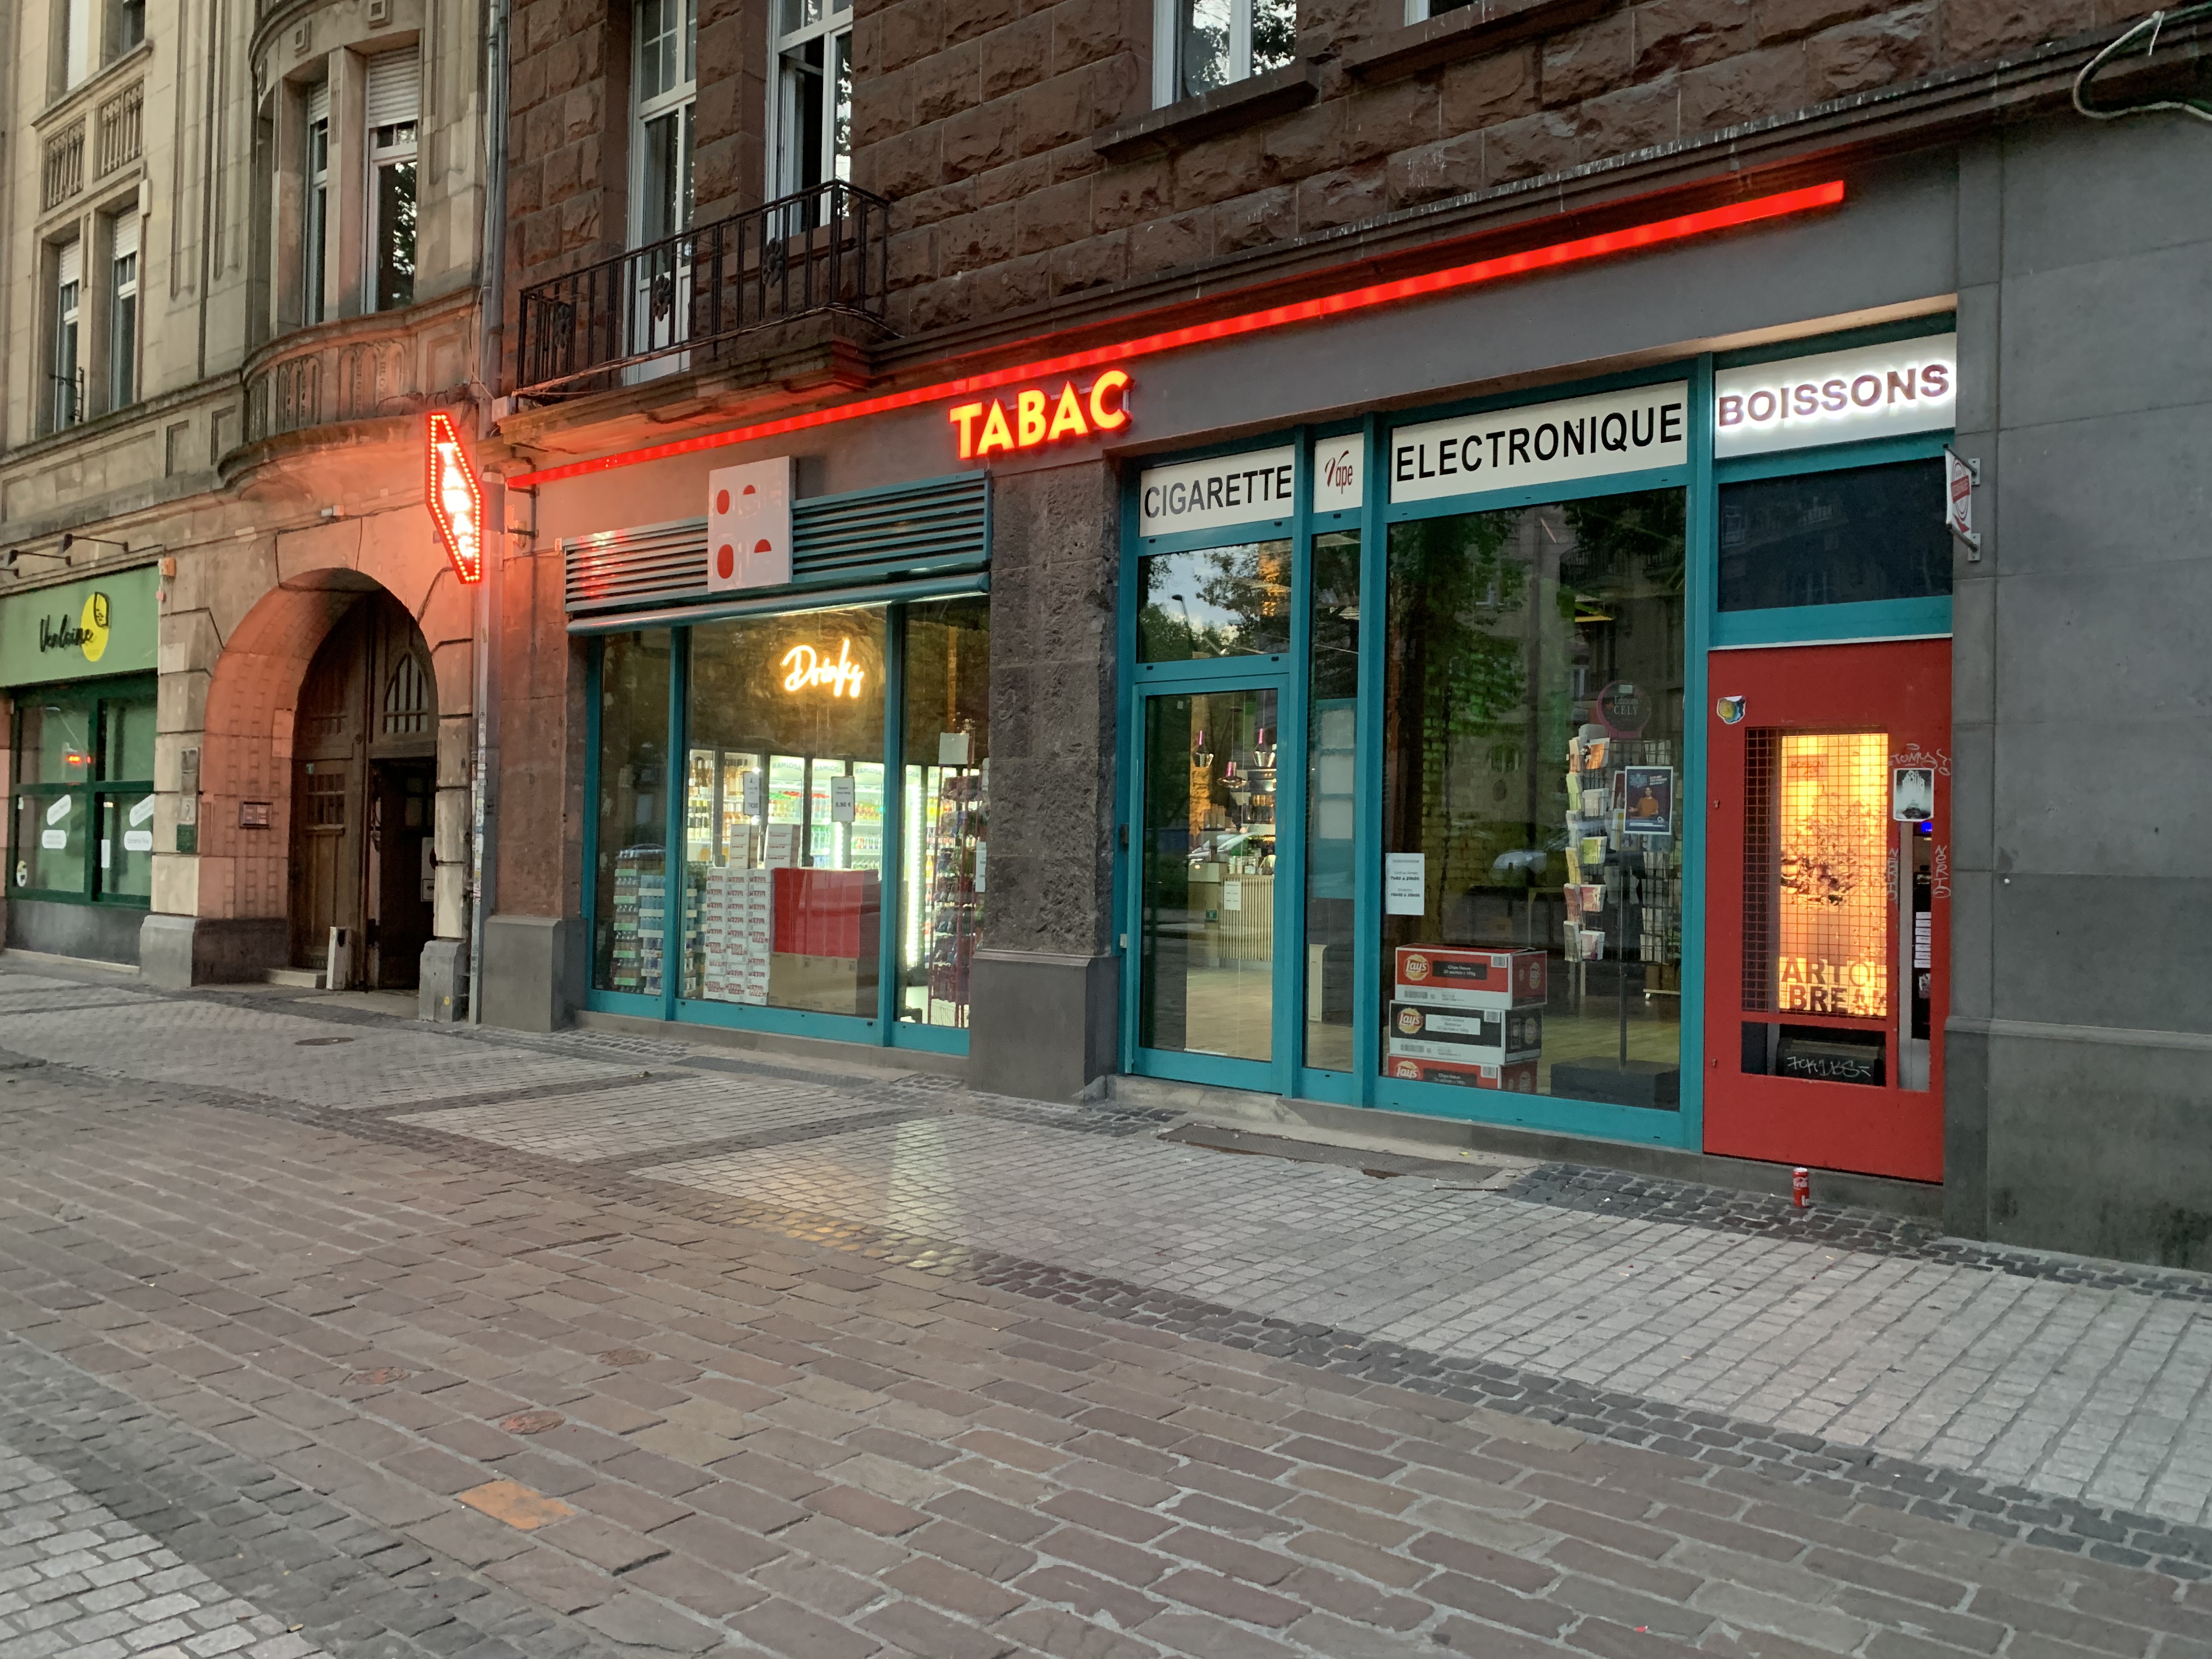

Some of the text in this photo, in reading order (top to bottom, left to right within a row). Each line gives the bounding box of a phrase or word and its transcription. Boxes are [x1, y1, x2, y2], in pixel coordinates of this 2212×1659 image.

[949, 370, 1129, 459] TABAC
[1718, 364, 1950, 427] BOISSONS
[1325, 450, 1353, 494] Vape
[1396, 403, 1683, 482] ELECTRONIQUE
[1144, 465, 1292, 518] CIGARETTE
